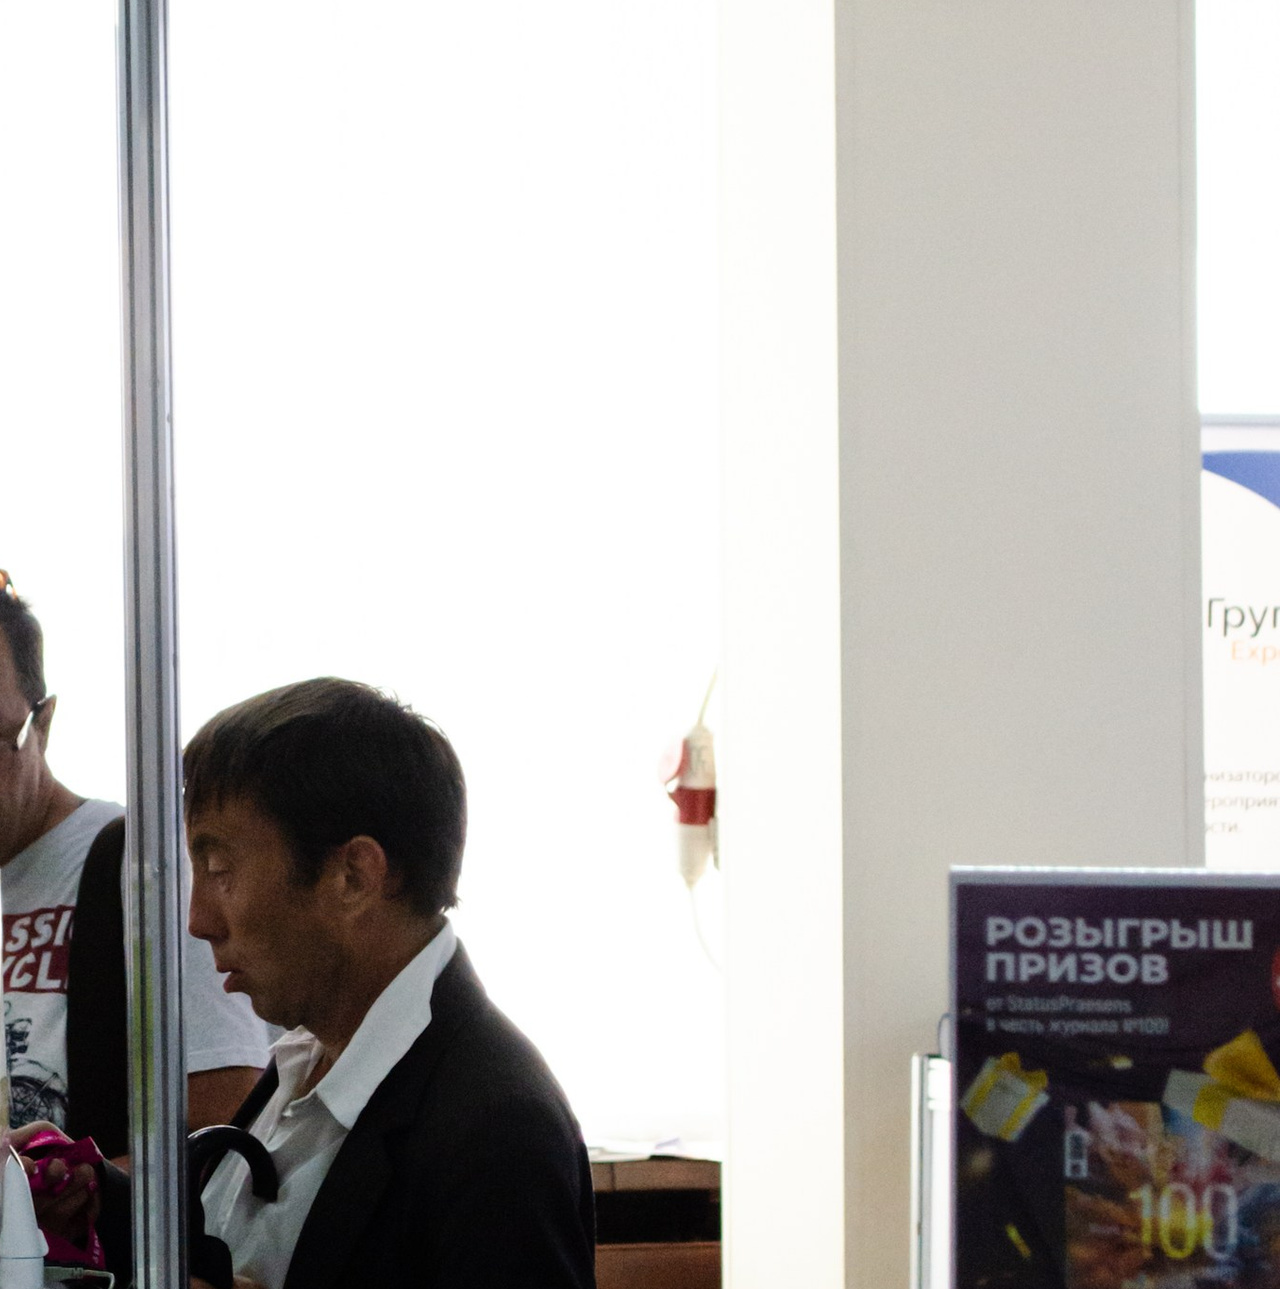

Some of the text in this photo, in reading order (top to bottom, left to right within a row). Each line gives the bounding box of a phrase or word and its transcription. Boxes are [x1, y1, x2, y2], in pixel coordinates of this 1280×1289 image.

[986, 916, 1254, 950] РОЗЫГРЫШ
[986, 952, 1170, 984] ПРИЗОВ
[1129, 1182, 1239, 1259] 100
